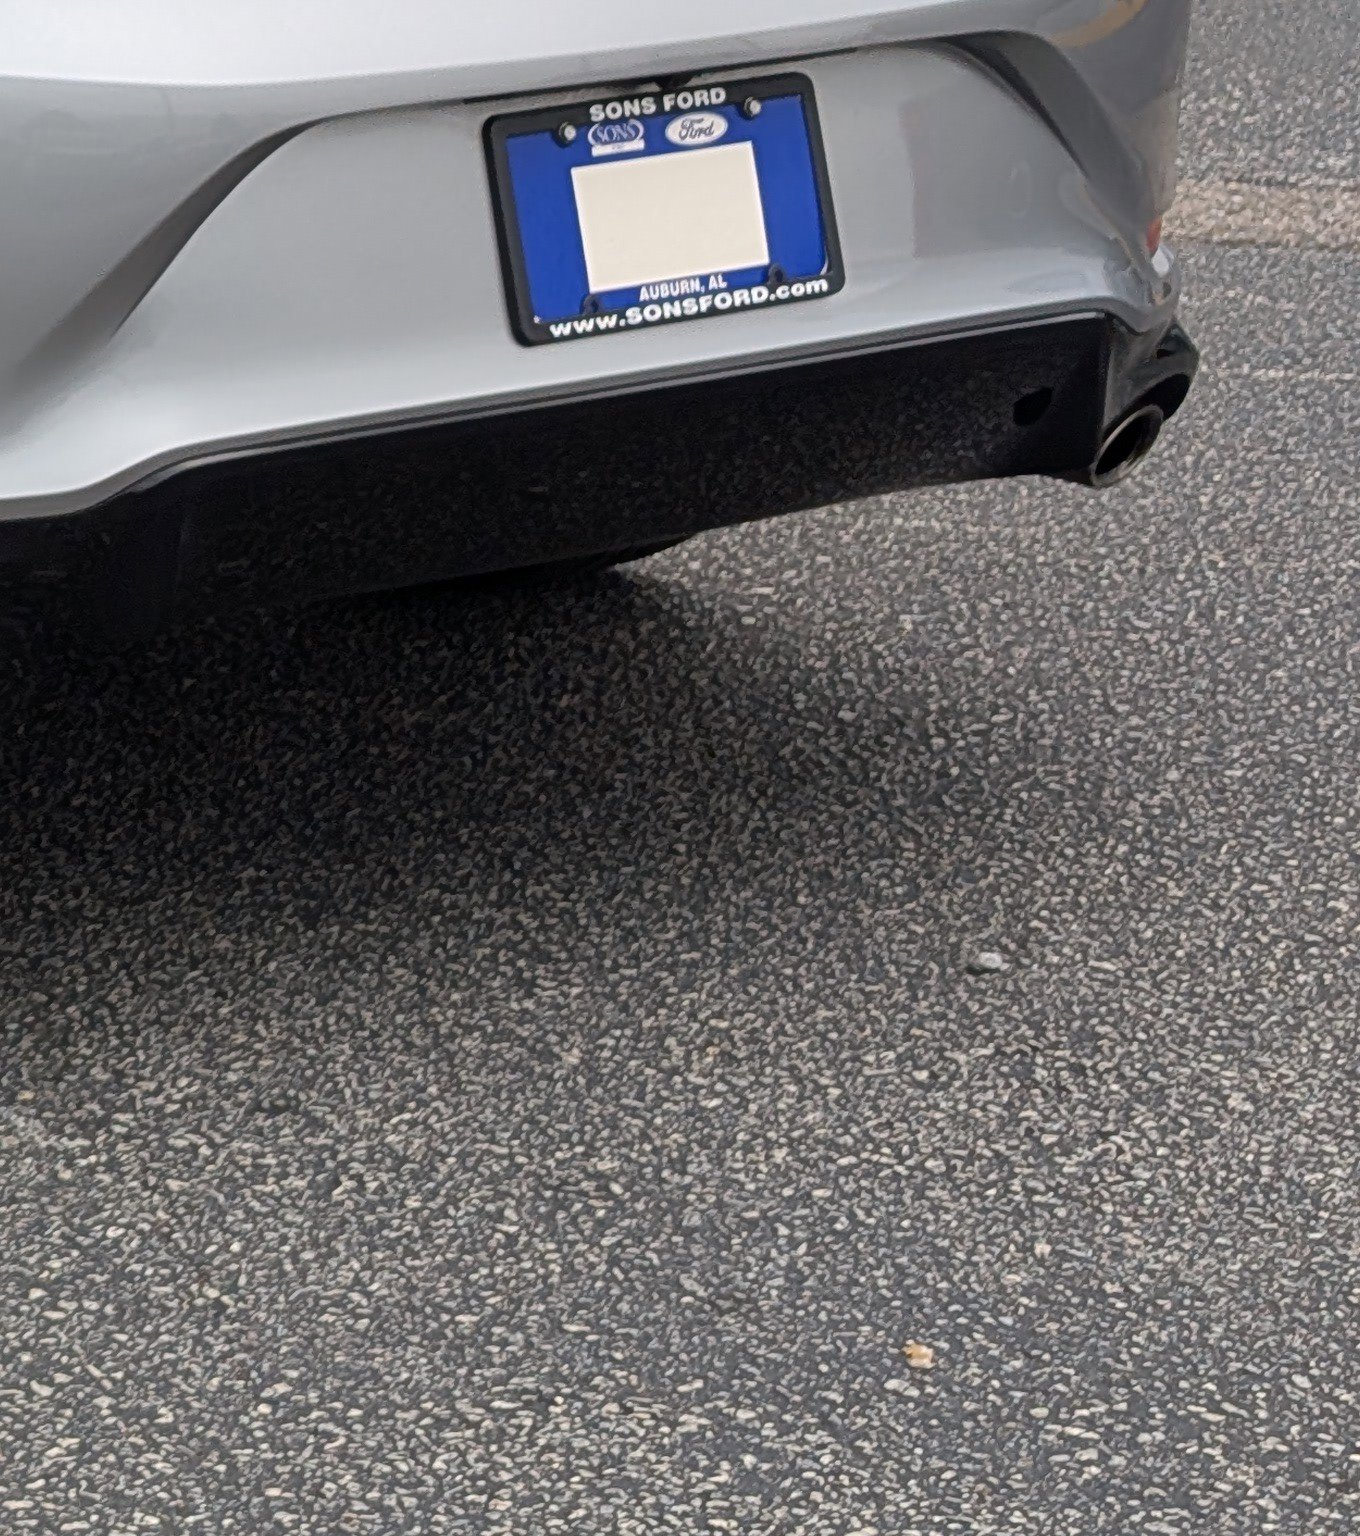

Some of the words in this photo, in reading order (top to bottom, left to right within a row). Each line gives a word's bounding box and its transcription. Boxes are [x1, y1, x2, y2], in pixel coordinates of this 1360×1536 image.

[589, 96, 657, 122] SONS
[663, 87, 726, 112] FORD
[596, 123, 636, 142] SONS
[679, 116, 715, 141] Ford
[639, 281, 705, 302] AUBURN,
[708, 274, 727, 289] AL
[549, 278, 829, 338] www.SONSFORD.com
